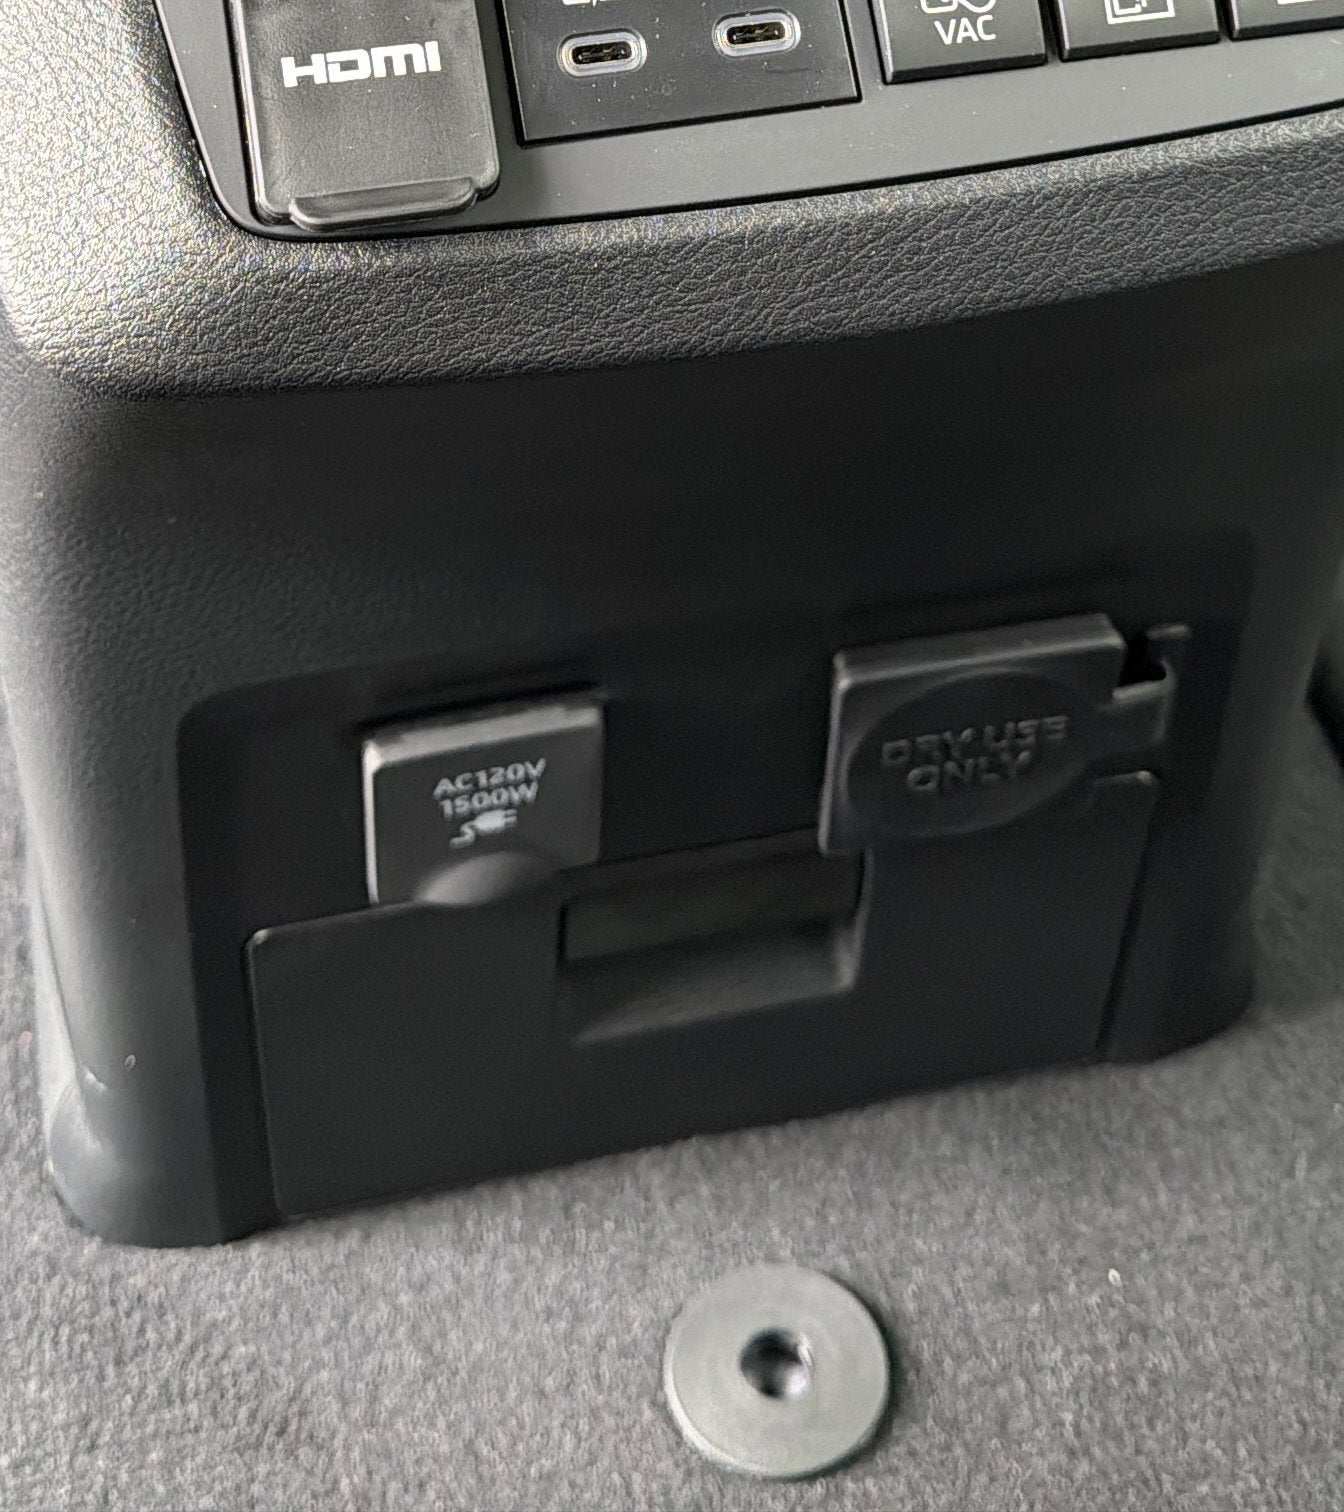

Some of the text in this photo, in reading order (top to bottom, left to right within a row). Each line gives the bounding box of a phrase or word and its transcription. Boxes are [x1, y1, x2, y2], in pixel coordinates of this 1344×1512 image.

[933, 14, 997, 46] VAC
[280, 40, 442, 88] HDMI
[982, 714, 1070, 752] USE
[433, 757, 547, 800] AC120V
[907, 748, 1032, 791] ONLY
[440, 781, 539, 821] 1500W
